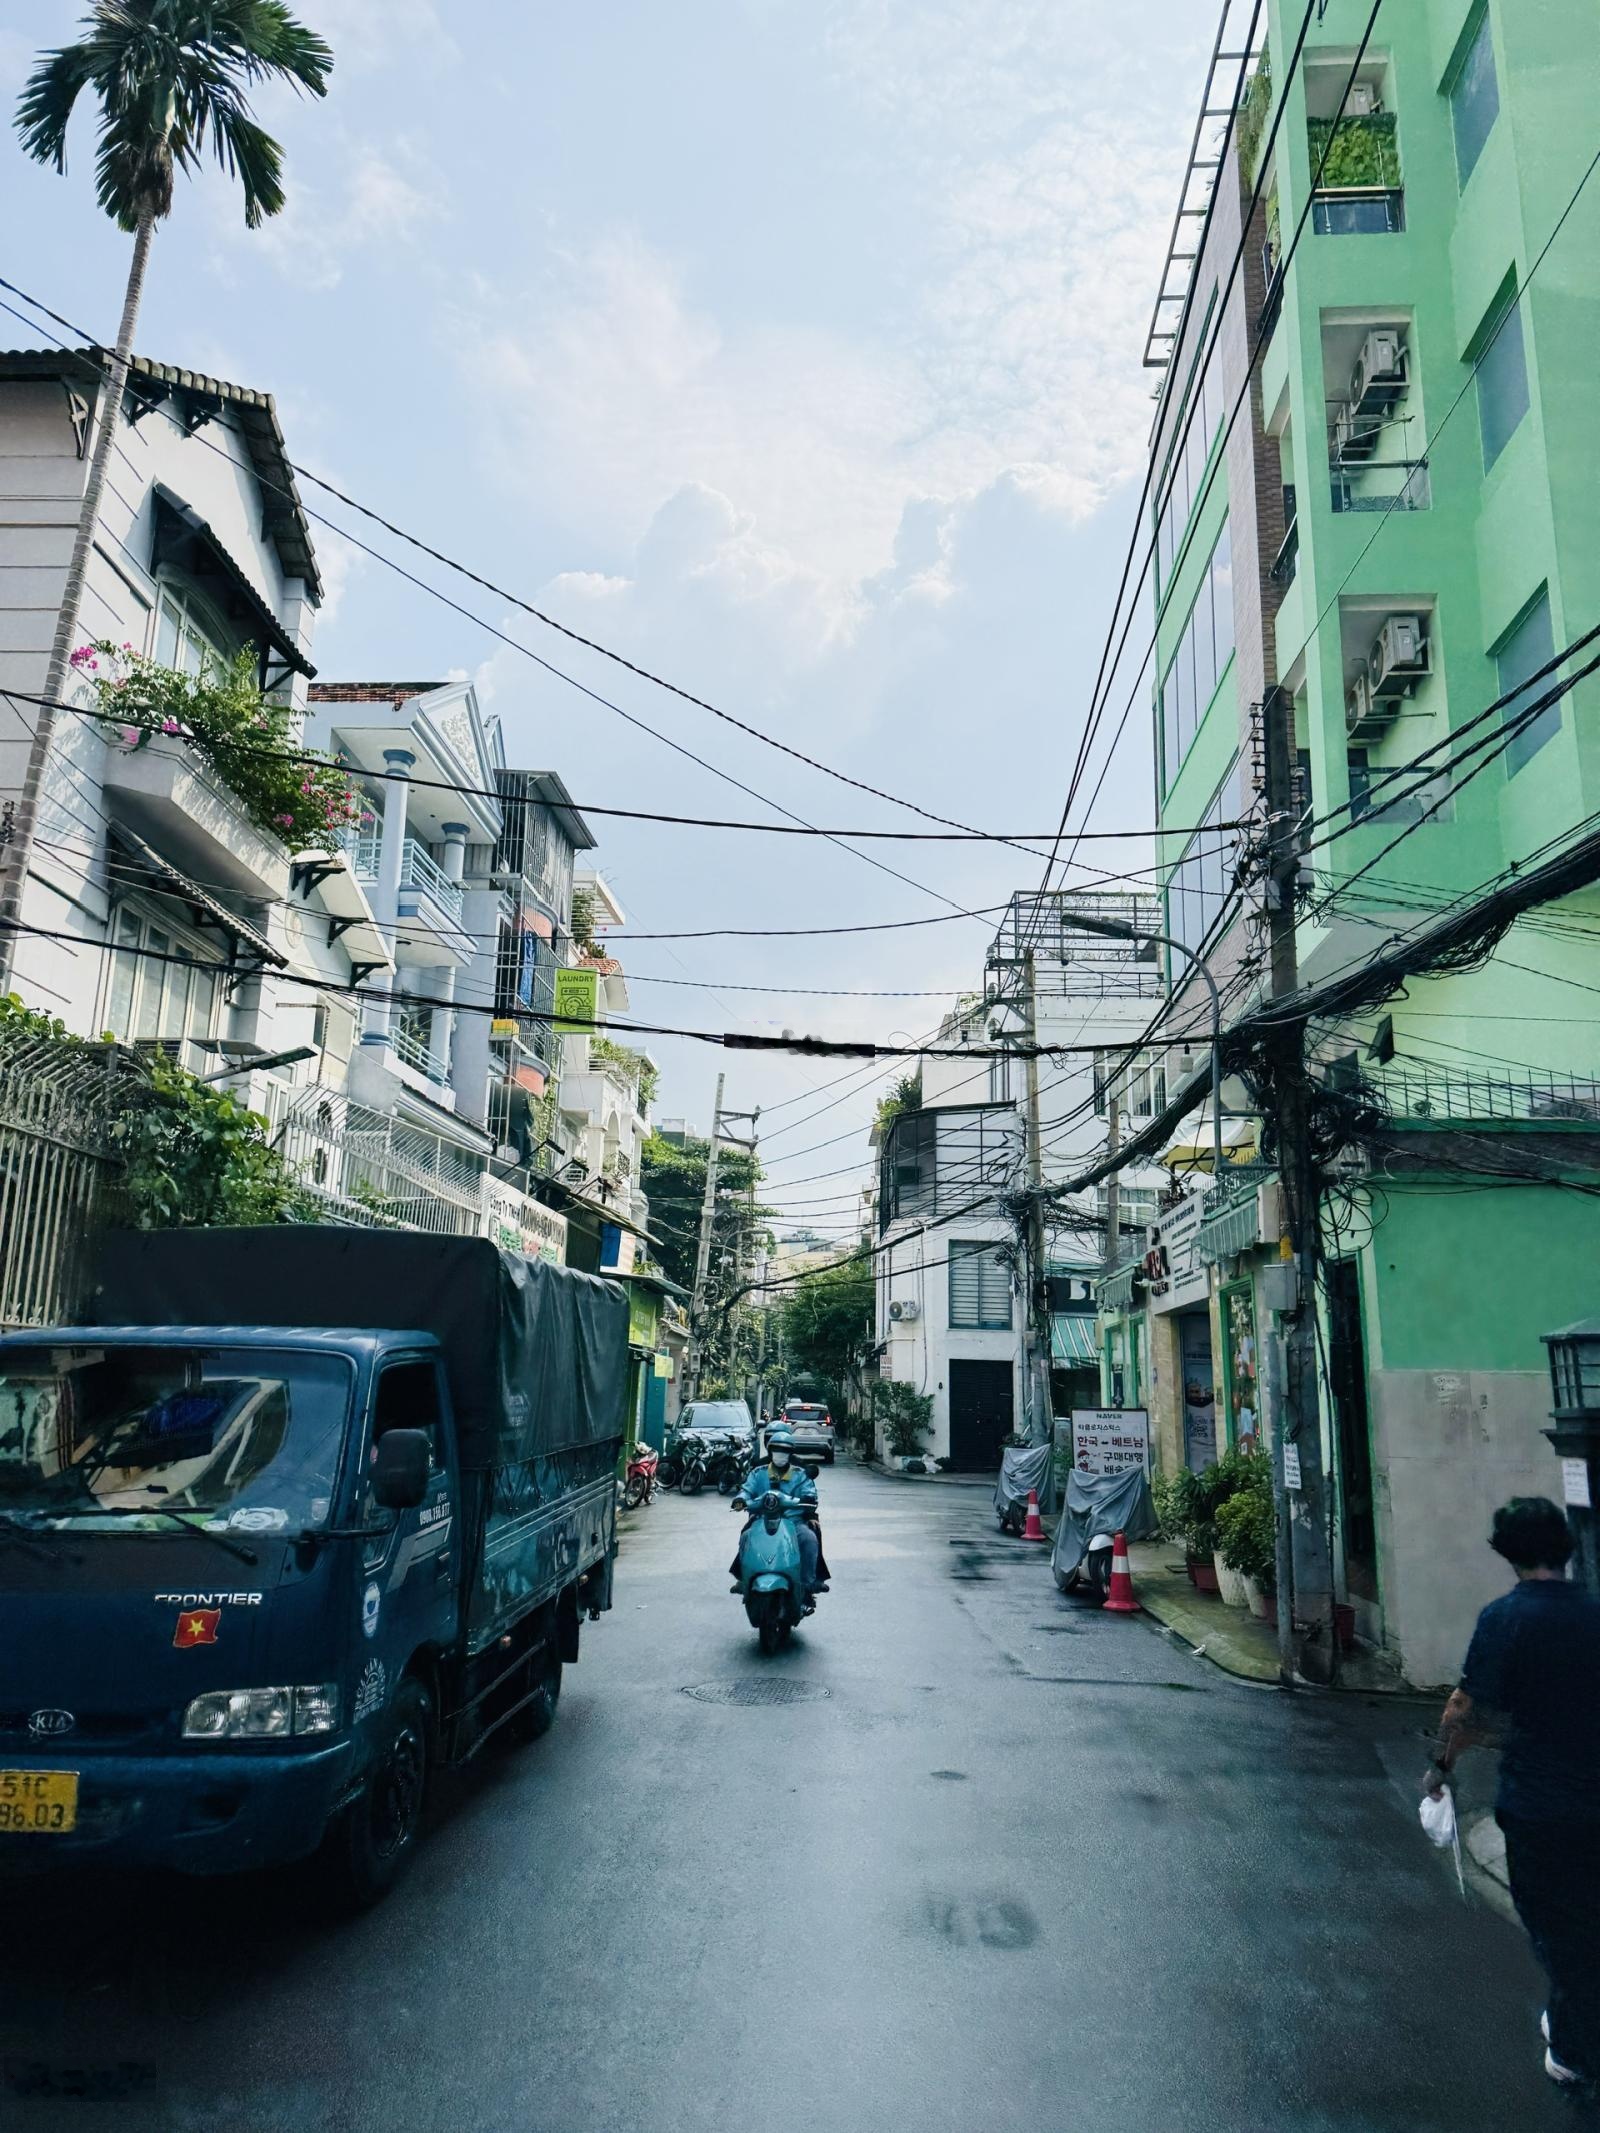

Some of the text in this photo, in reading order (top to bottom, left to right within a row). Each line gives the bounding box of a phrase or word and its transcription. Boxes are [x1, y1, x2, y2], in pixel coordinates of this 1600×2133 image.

[557, 975, 594, 983] LAUNDRY
[1077, 1436, 1098, 1447] 한국
[1112, 1436, 1144, 1448] 베트남
[1103, 1452, 1144, 1463] 구매대행
[153, 1593, 263, 1606] FRONTIER
[3, 1775, 48, 1799] 51C
